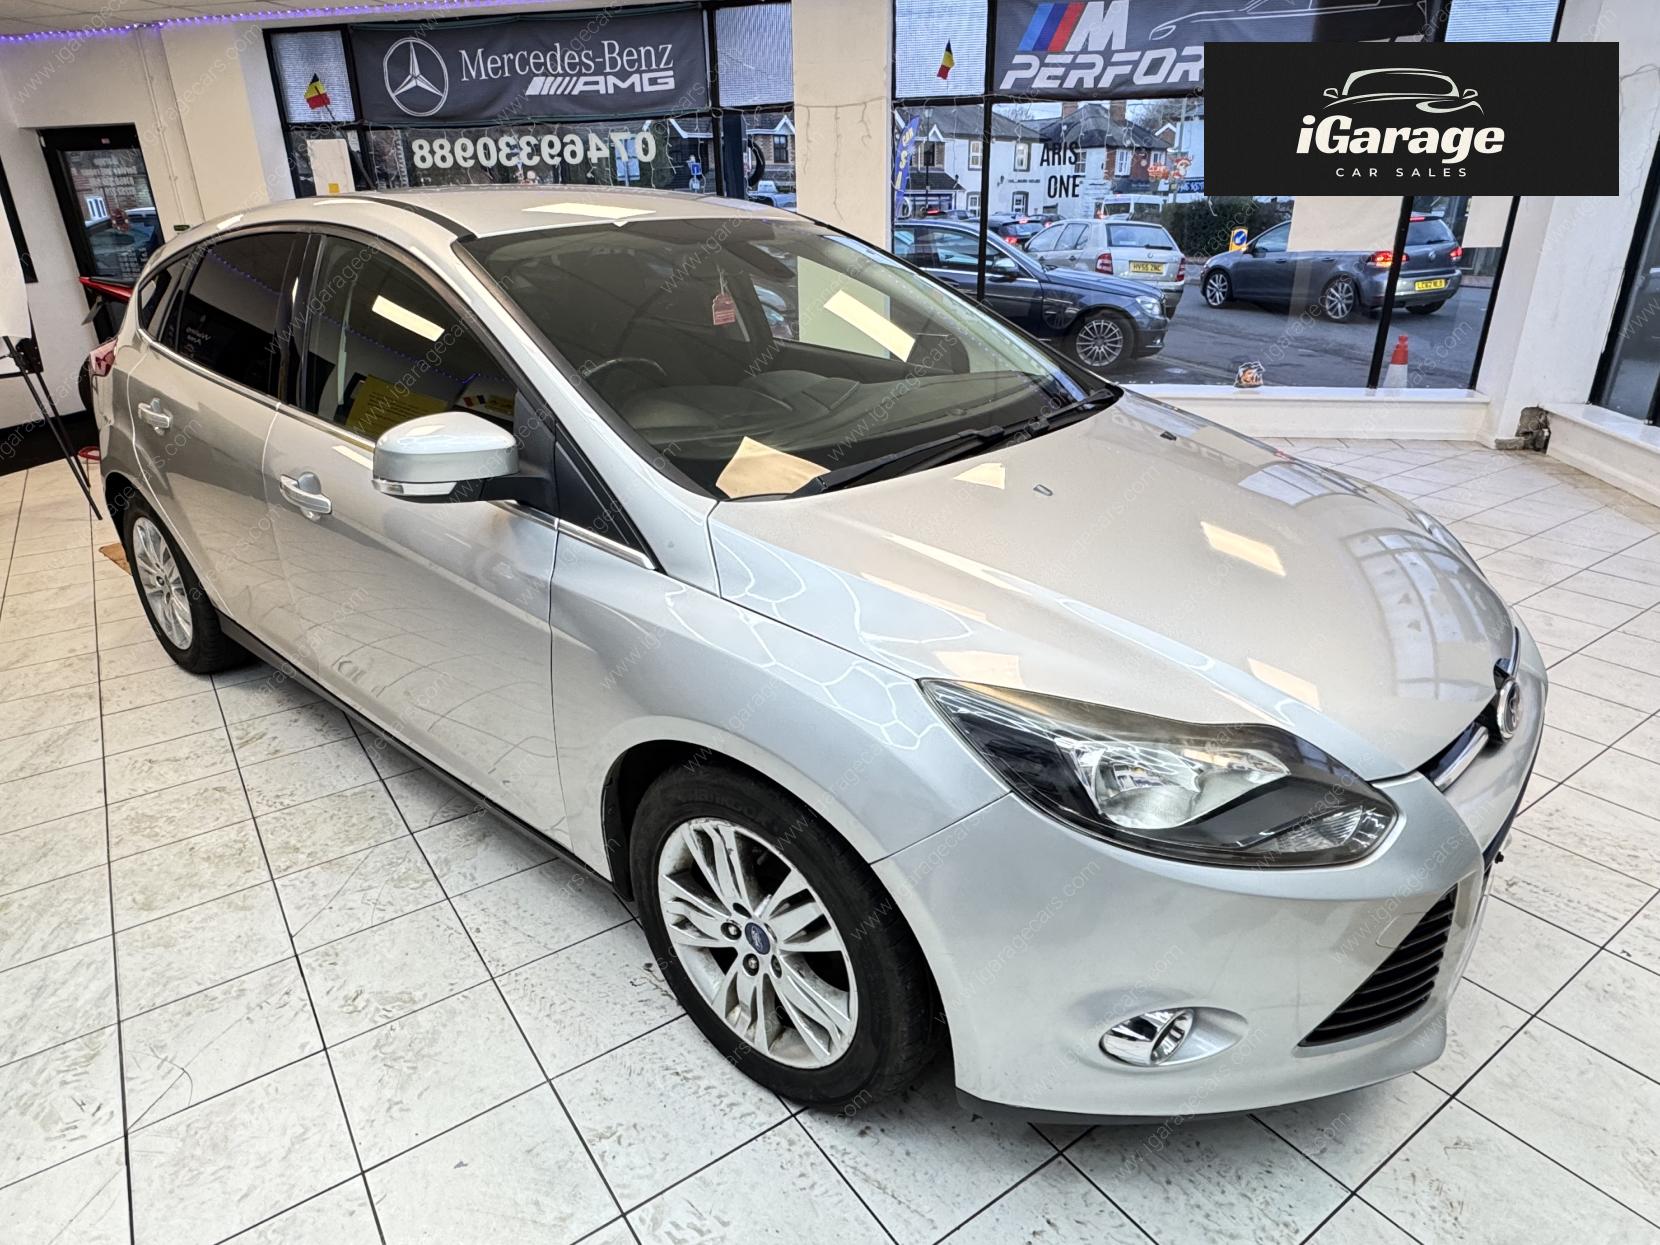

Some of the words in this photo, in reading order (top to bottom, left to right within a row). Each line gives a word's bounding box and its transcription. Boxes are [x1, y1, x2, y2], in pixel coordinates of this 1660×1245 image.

[459, 39, 673, 82] Mercedes-Benz
[999, 45, 1205, 90] PERFOR
[571, 70, 675, 95] AMG
[1040, 141, 1080, 167] ARIS
[1047, 174, 1081, 199] ONE
